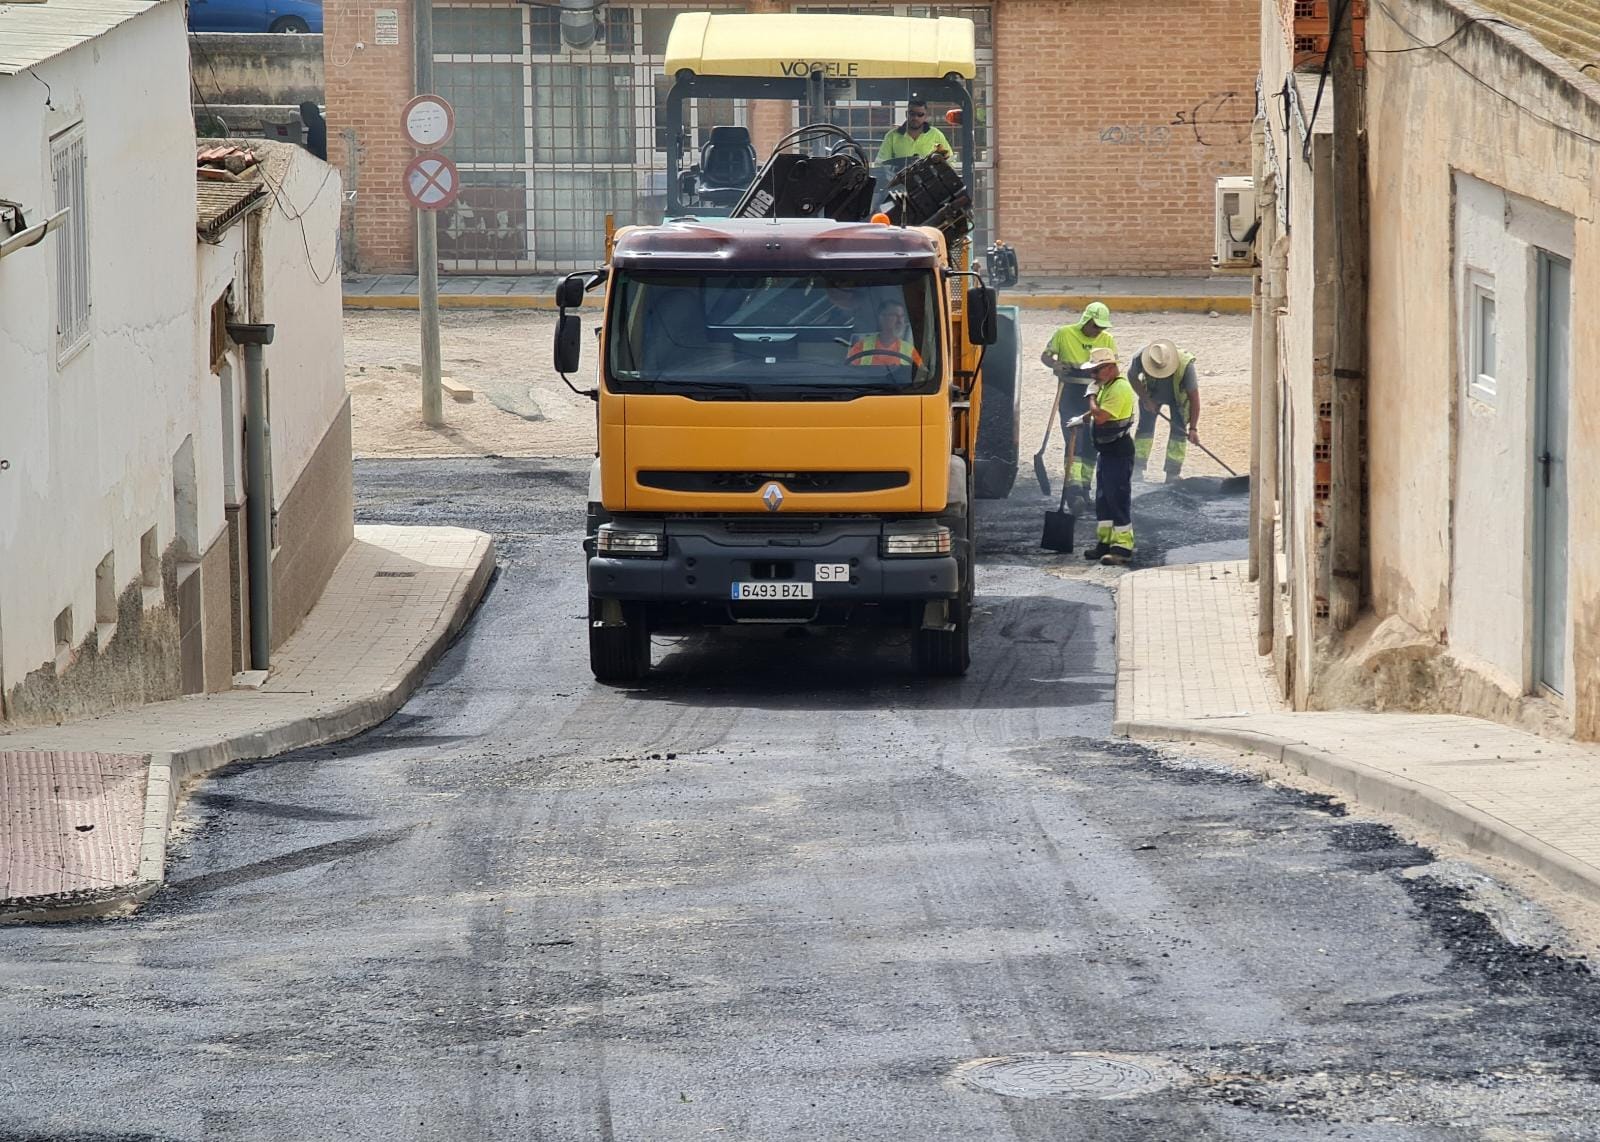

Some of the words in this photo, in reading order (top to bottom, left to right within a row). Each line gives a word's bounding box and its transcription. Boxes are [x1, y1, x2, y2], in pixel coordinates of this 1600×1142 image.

[741, 189, 774, 219] IAB
[820, 566, 845, 580] SP
[742, 584, 777, 598] 6493
[782, 584, 809, 598] BZL
